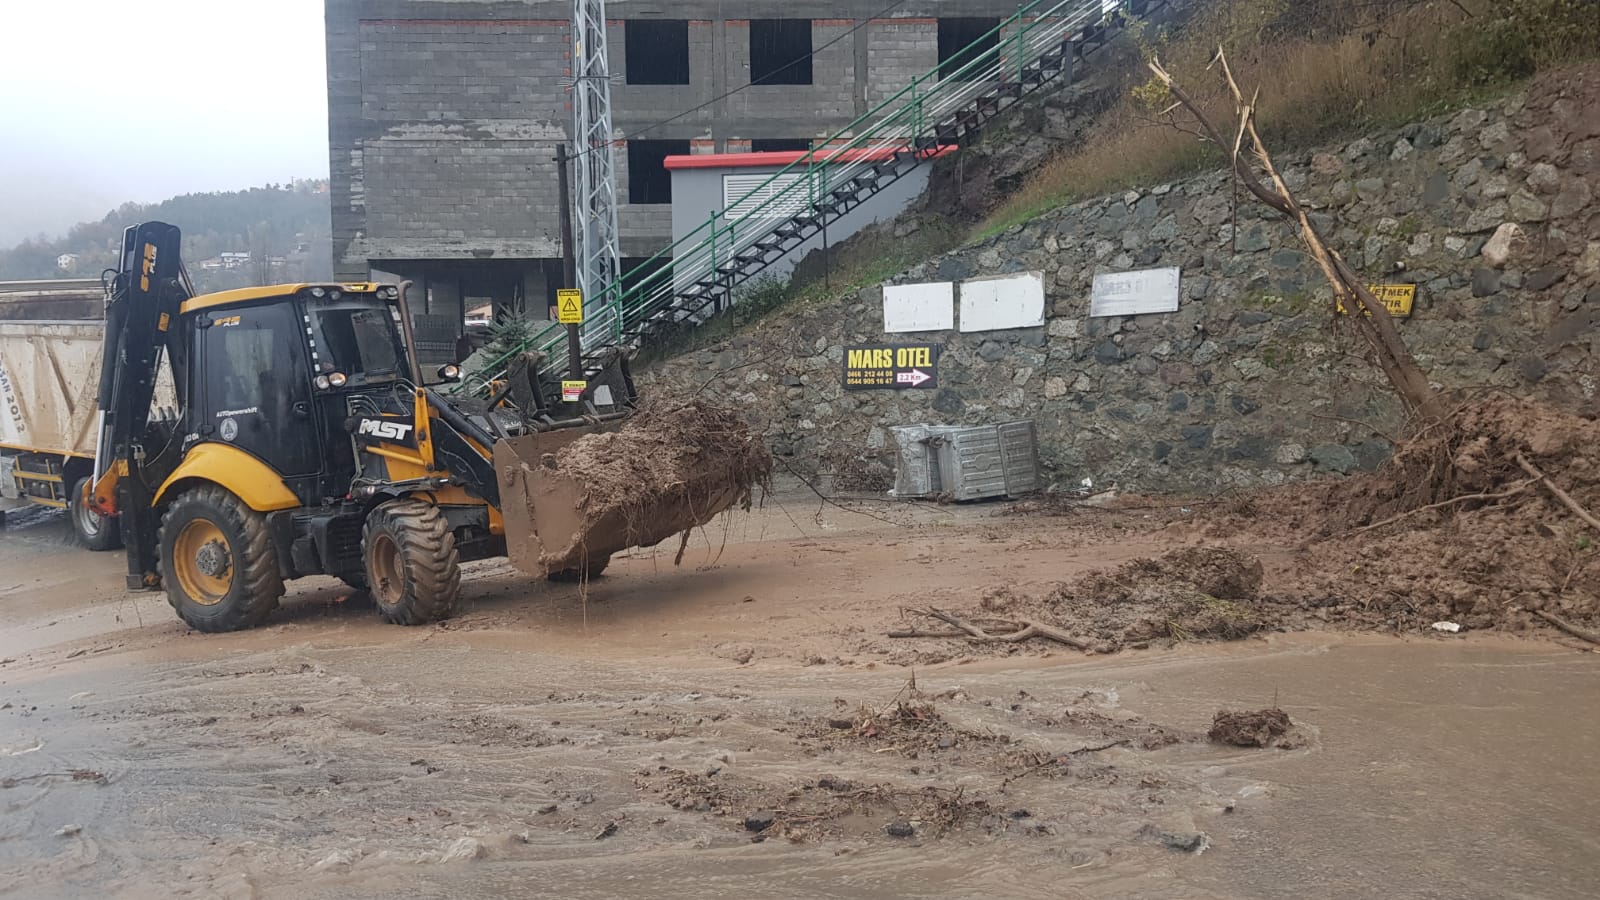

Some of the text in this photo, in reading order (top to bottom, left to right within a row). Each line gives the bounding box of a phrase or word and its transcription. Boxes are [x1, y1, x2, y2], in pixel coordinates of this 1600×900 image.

[847, 347, 933, 369] MARS OTEL
[6, 395, 25, 433] 2012
[358, 418, 413, 440] MST
